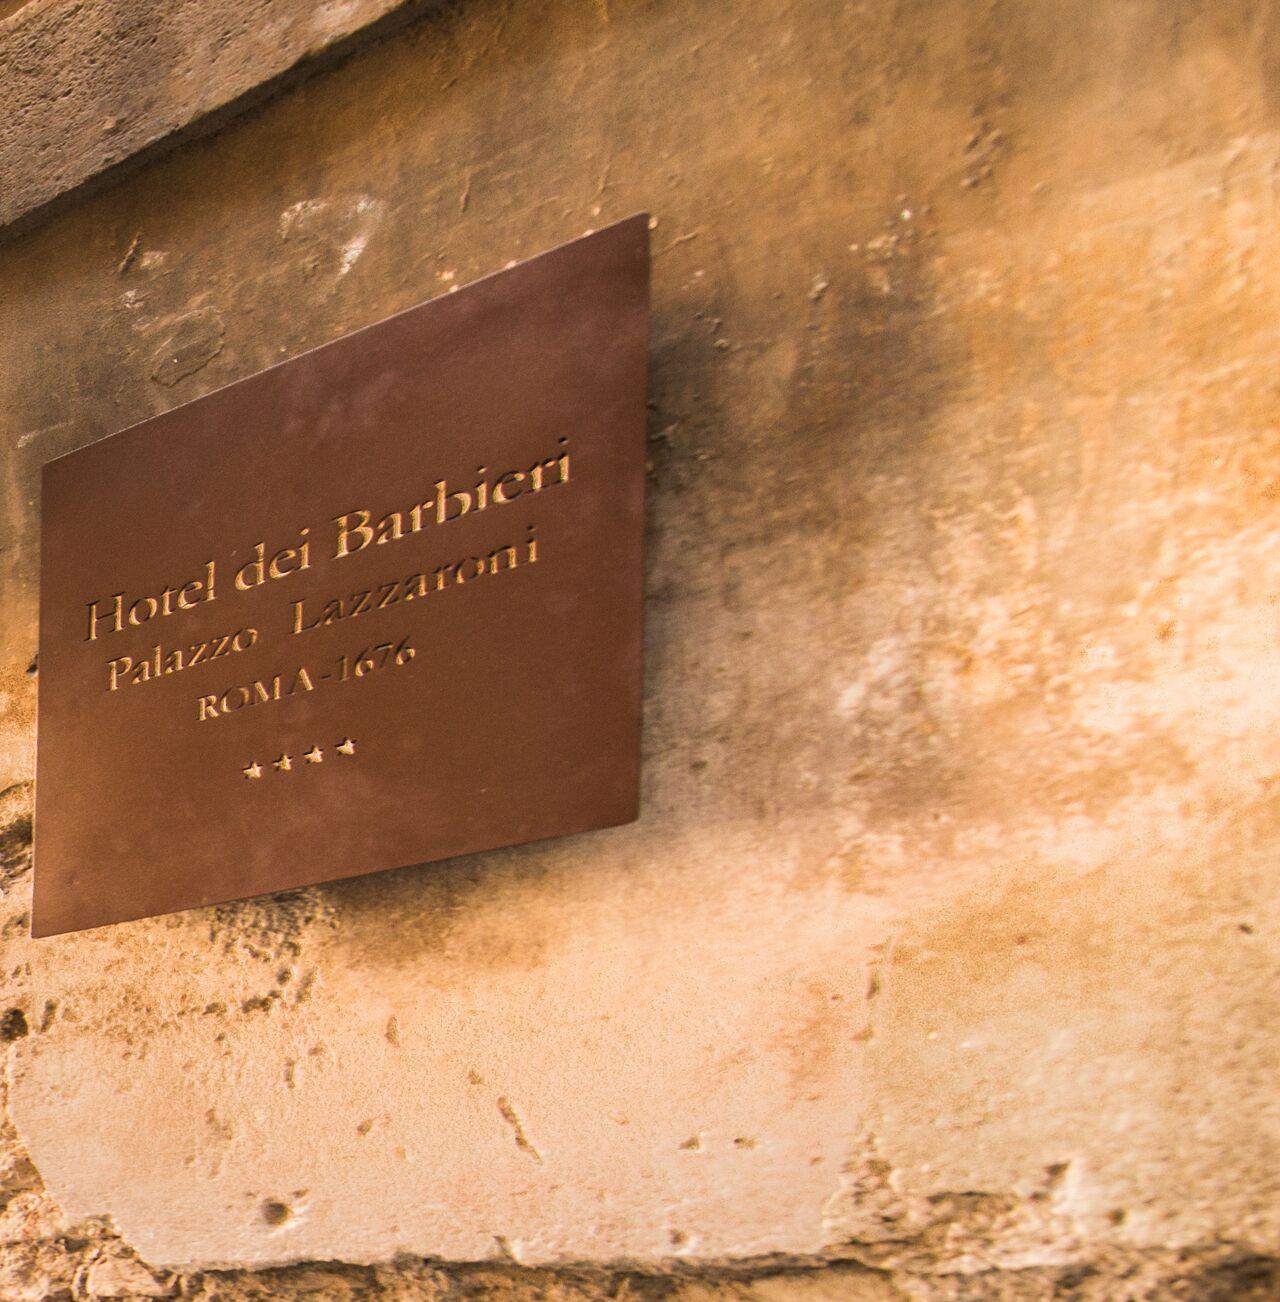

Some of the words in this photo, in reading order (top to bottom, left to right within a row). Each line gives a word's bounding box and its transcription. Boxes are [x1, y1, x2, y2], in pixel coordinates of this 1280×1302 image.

[85, 560, 218, 643] Hotel
[234, 527, 312, 592] dei
[330, 436, 571, 561] Barbieri
[106, 627, 259, 692] Palazzo
[289, 525, 539, 635] Lazzaroni
